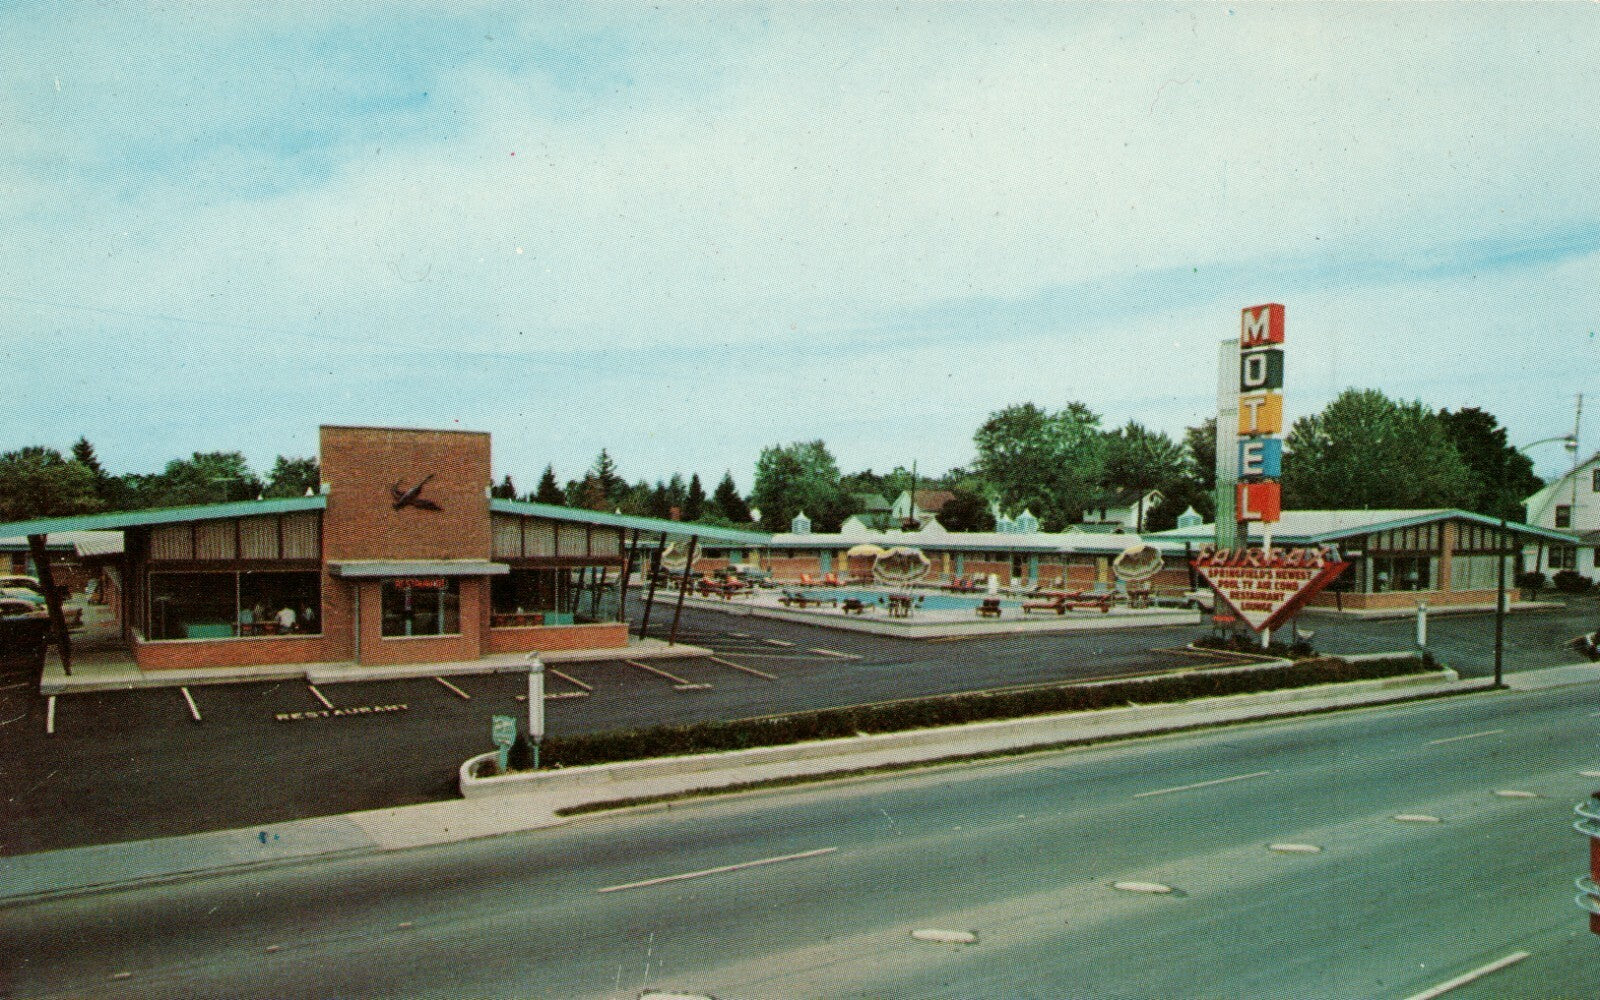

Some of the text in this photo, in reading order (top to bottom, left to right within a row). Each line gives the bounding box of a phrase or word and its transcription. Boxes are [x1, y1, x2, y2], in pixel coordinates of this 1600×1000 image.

[1242, 308, 1270, 520] MOTEL
[1196, 543, 1331, 567] FAIRFAX
[1208, 568, 1312, 579] SPRINGFIELD'S NEWEST
[1218, 579, 1239, 589] POOL
[1256, 580, 1272, 590] AIR
[1275, 580, 1299, 590] COND
[1230, 591, 1285, 601] RESTAURANT
[1241, 602, 1272, 612] LOUNGE
[275, 704, 408, 720] RESTAURANT
